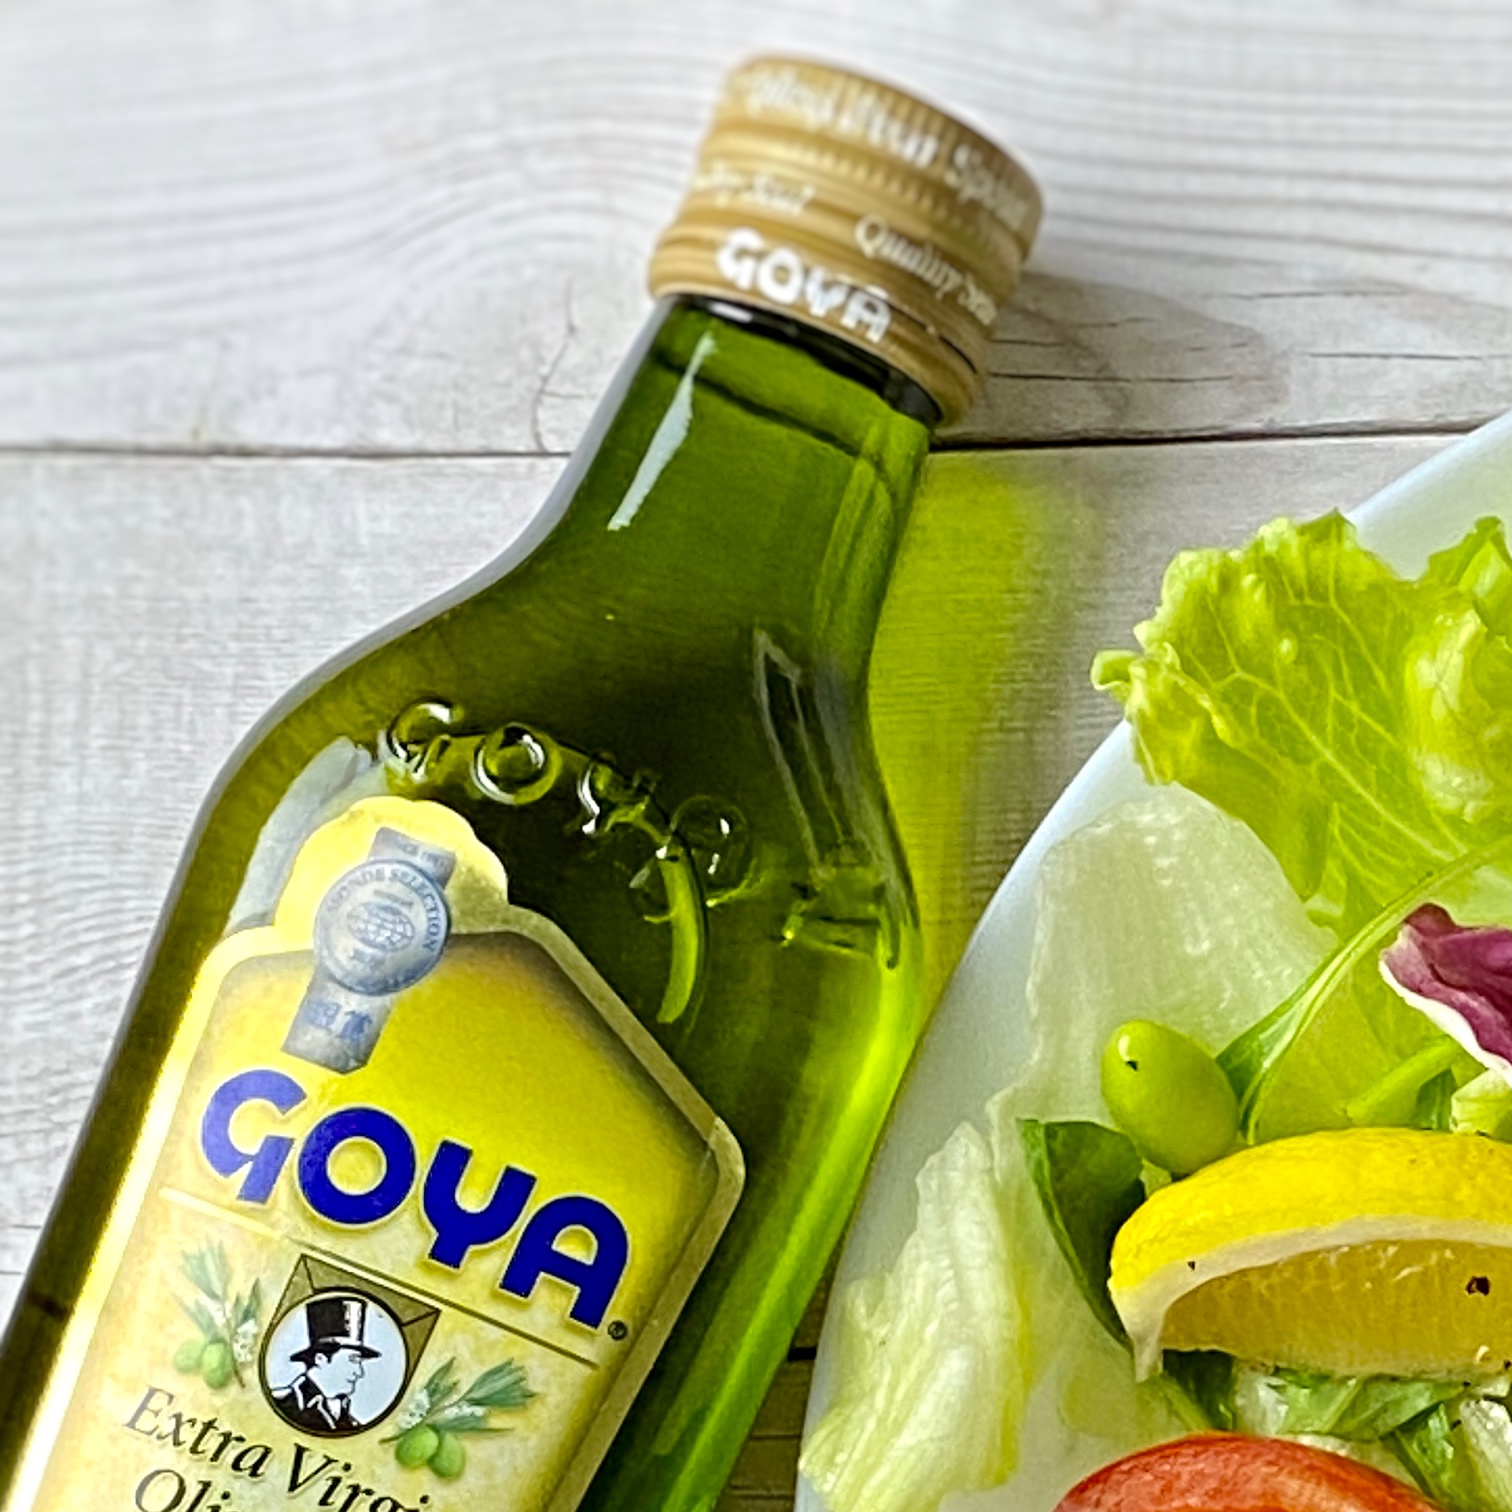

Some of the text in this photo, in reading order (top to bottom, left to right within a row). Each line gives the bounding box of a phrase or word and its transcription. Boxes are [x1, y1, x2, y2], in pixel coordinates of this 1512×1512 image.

[715, 226, 893, 343] GOYA
[201, 1069, 630, 1329] GOYA
[125, 1386, 272, 1478] Extra
